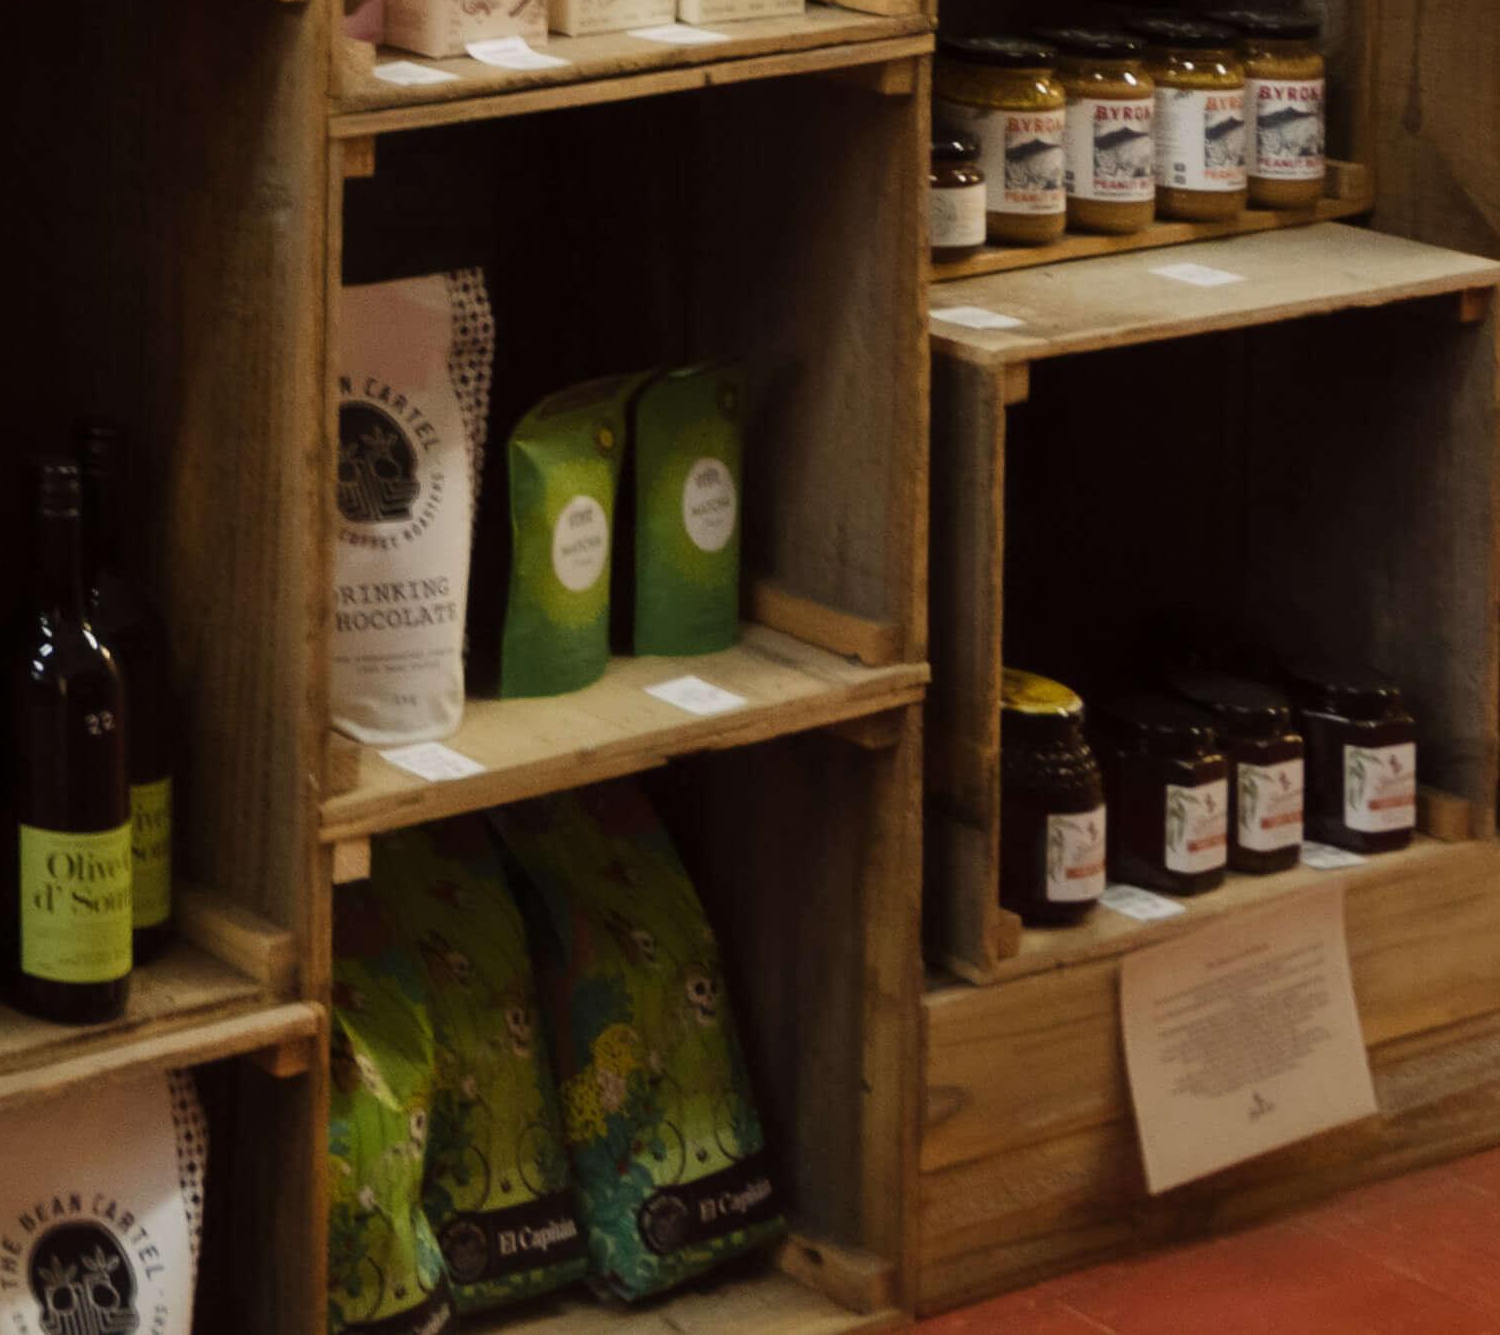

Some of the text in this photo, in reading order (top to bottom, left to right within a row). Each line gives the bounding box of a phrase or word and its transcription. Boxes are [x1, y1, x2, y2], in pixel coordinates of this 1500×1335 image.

[365, 376, 441, 452] CARTEL
[1, 1192, 165, 1291] THE BEAN CARTEL
